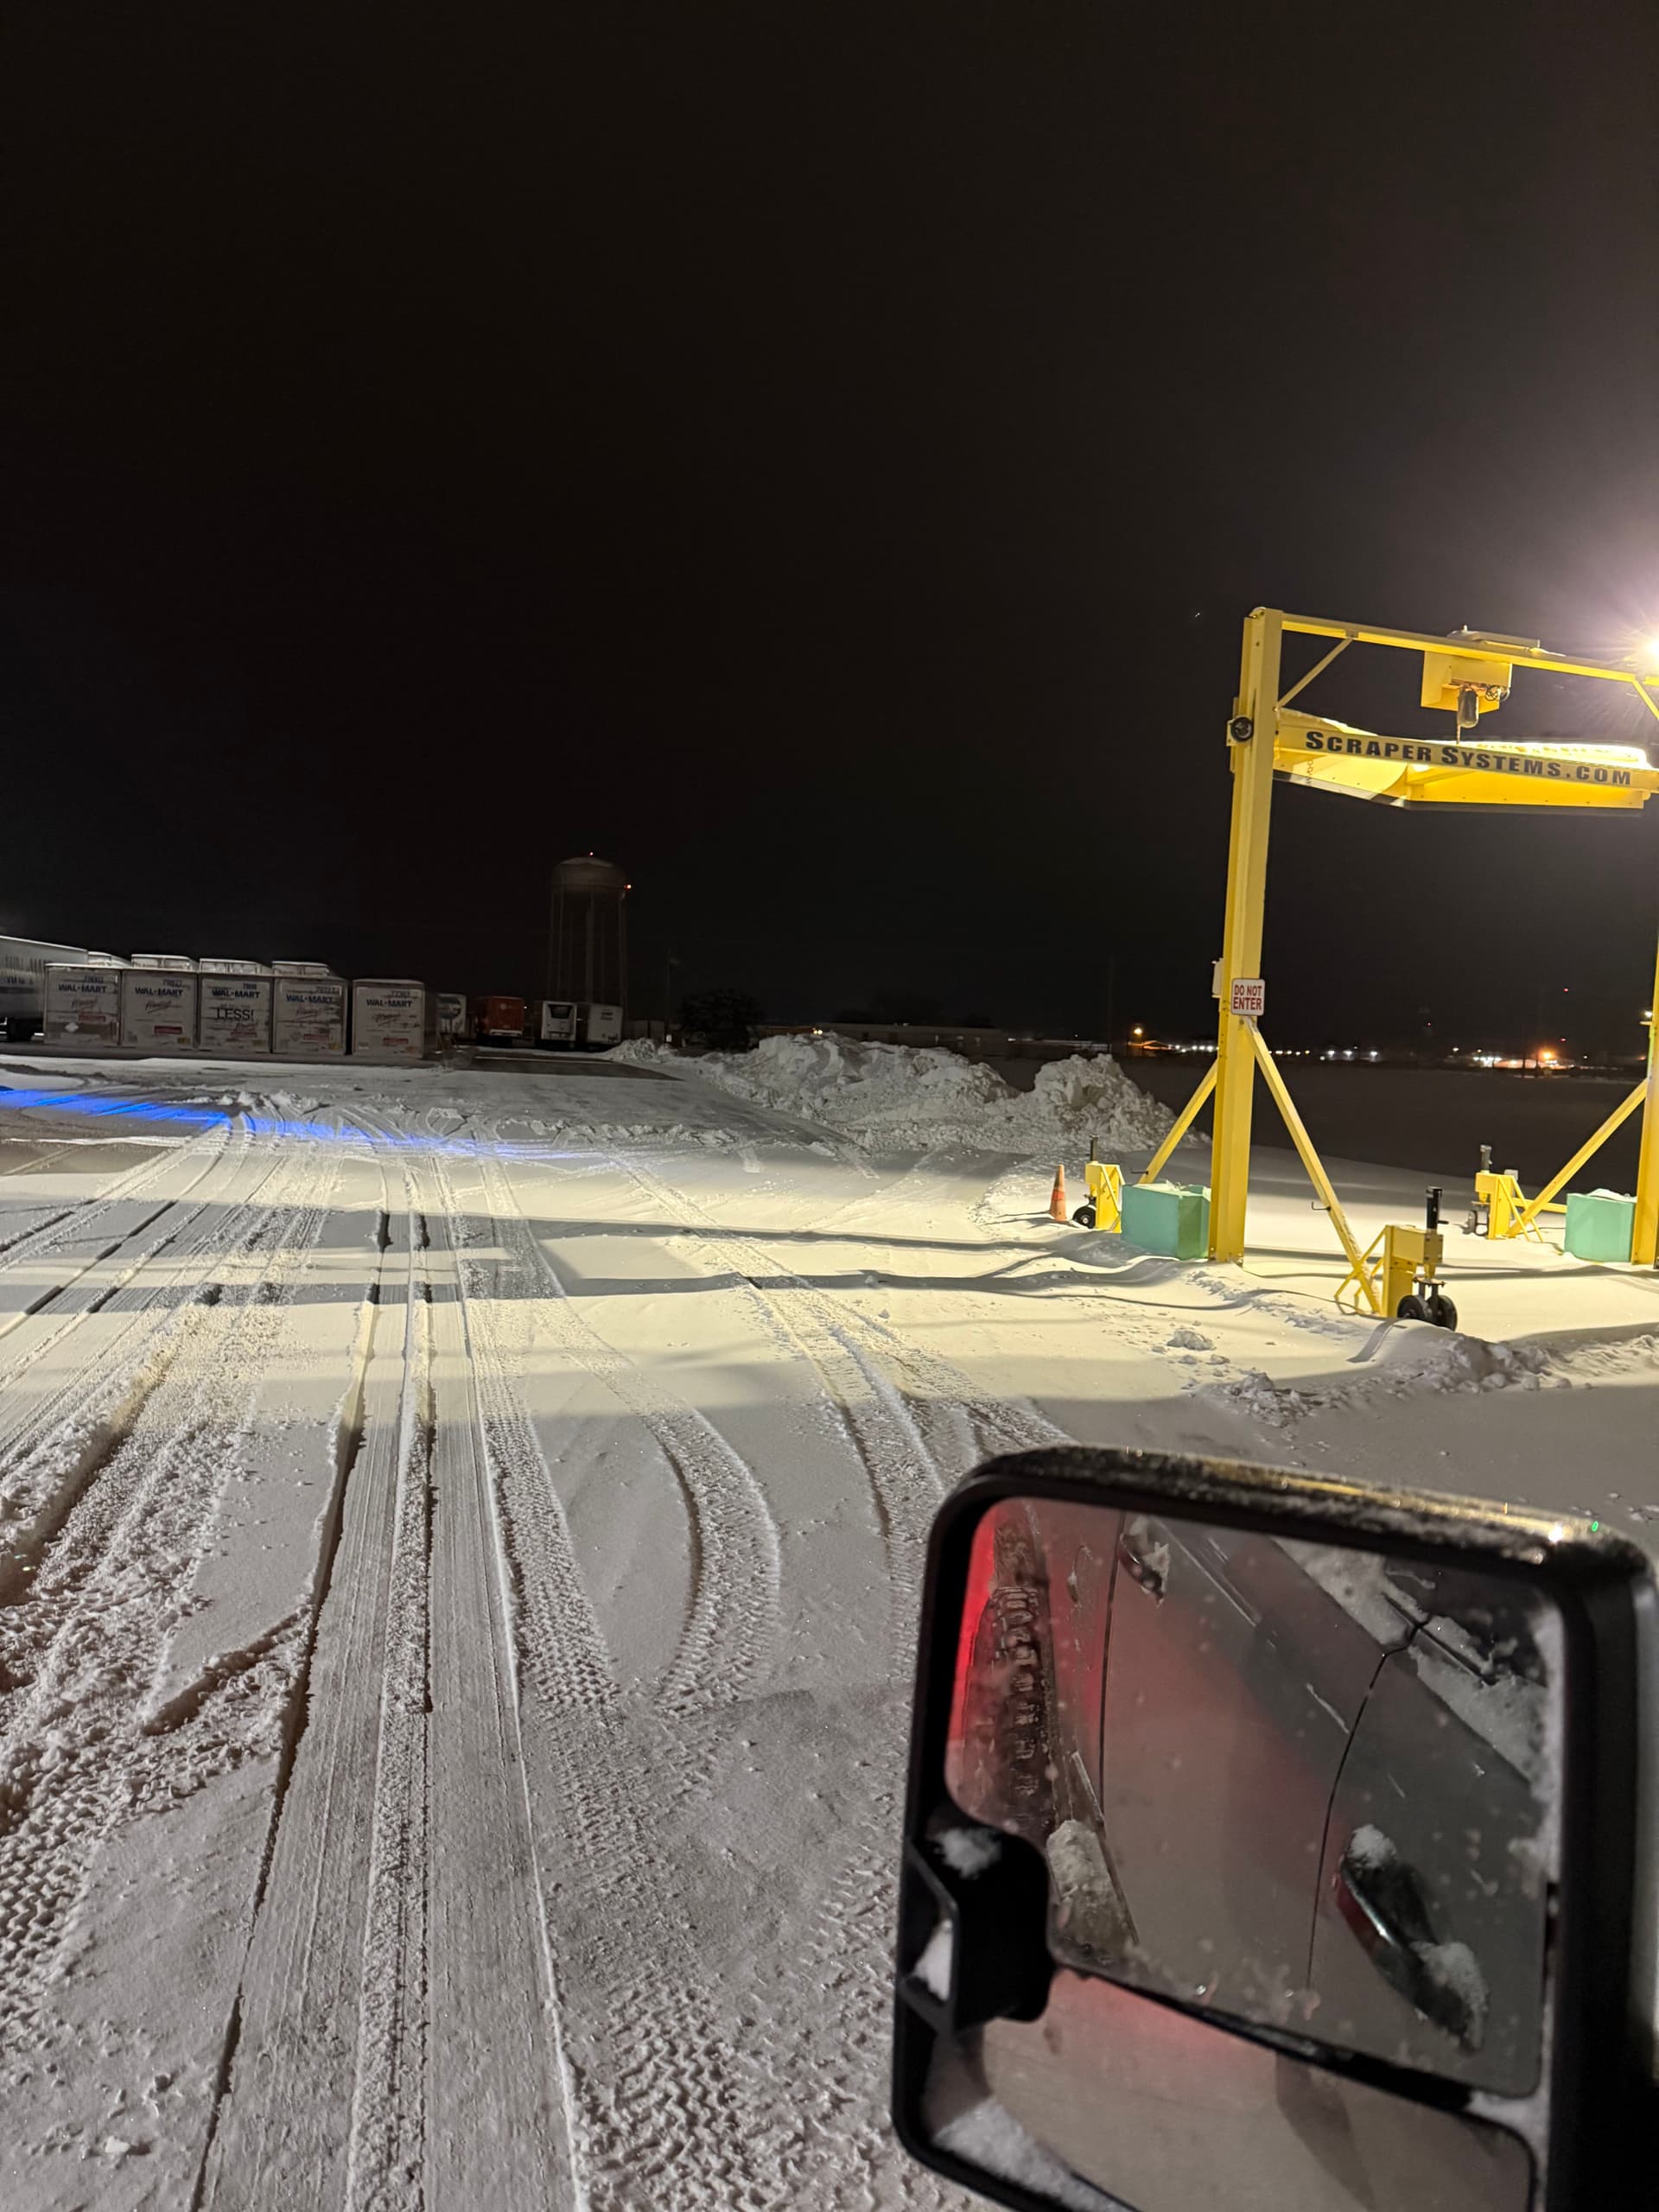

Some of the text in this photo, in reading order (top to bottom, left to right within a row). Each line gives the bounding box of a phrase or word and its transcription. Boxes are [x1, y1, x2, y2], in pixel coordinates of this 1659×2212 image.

[1305, 730, 1631, 786] SCRAPER SYSTEMS.COM
[1235, 984, 1262, 996] DO NOT
[1233, 997, 1262, 1010] ENTER
[216, 1008, 254, 1021] LESS!
